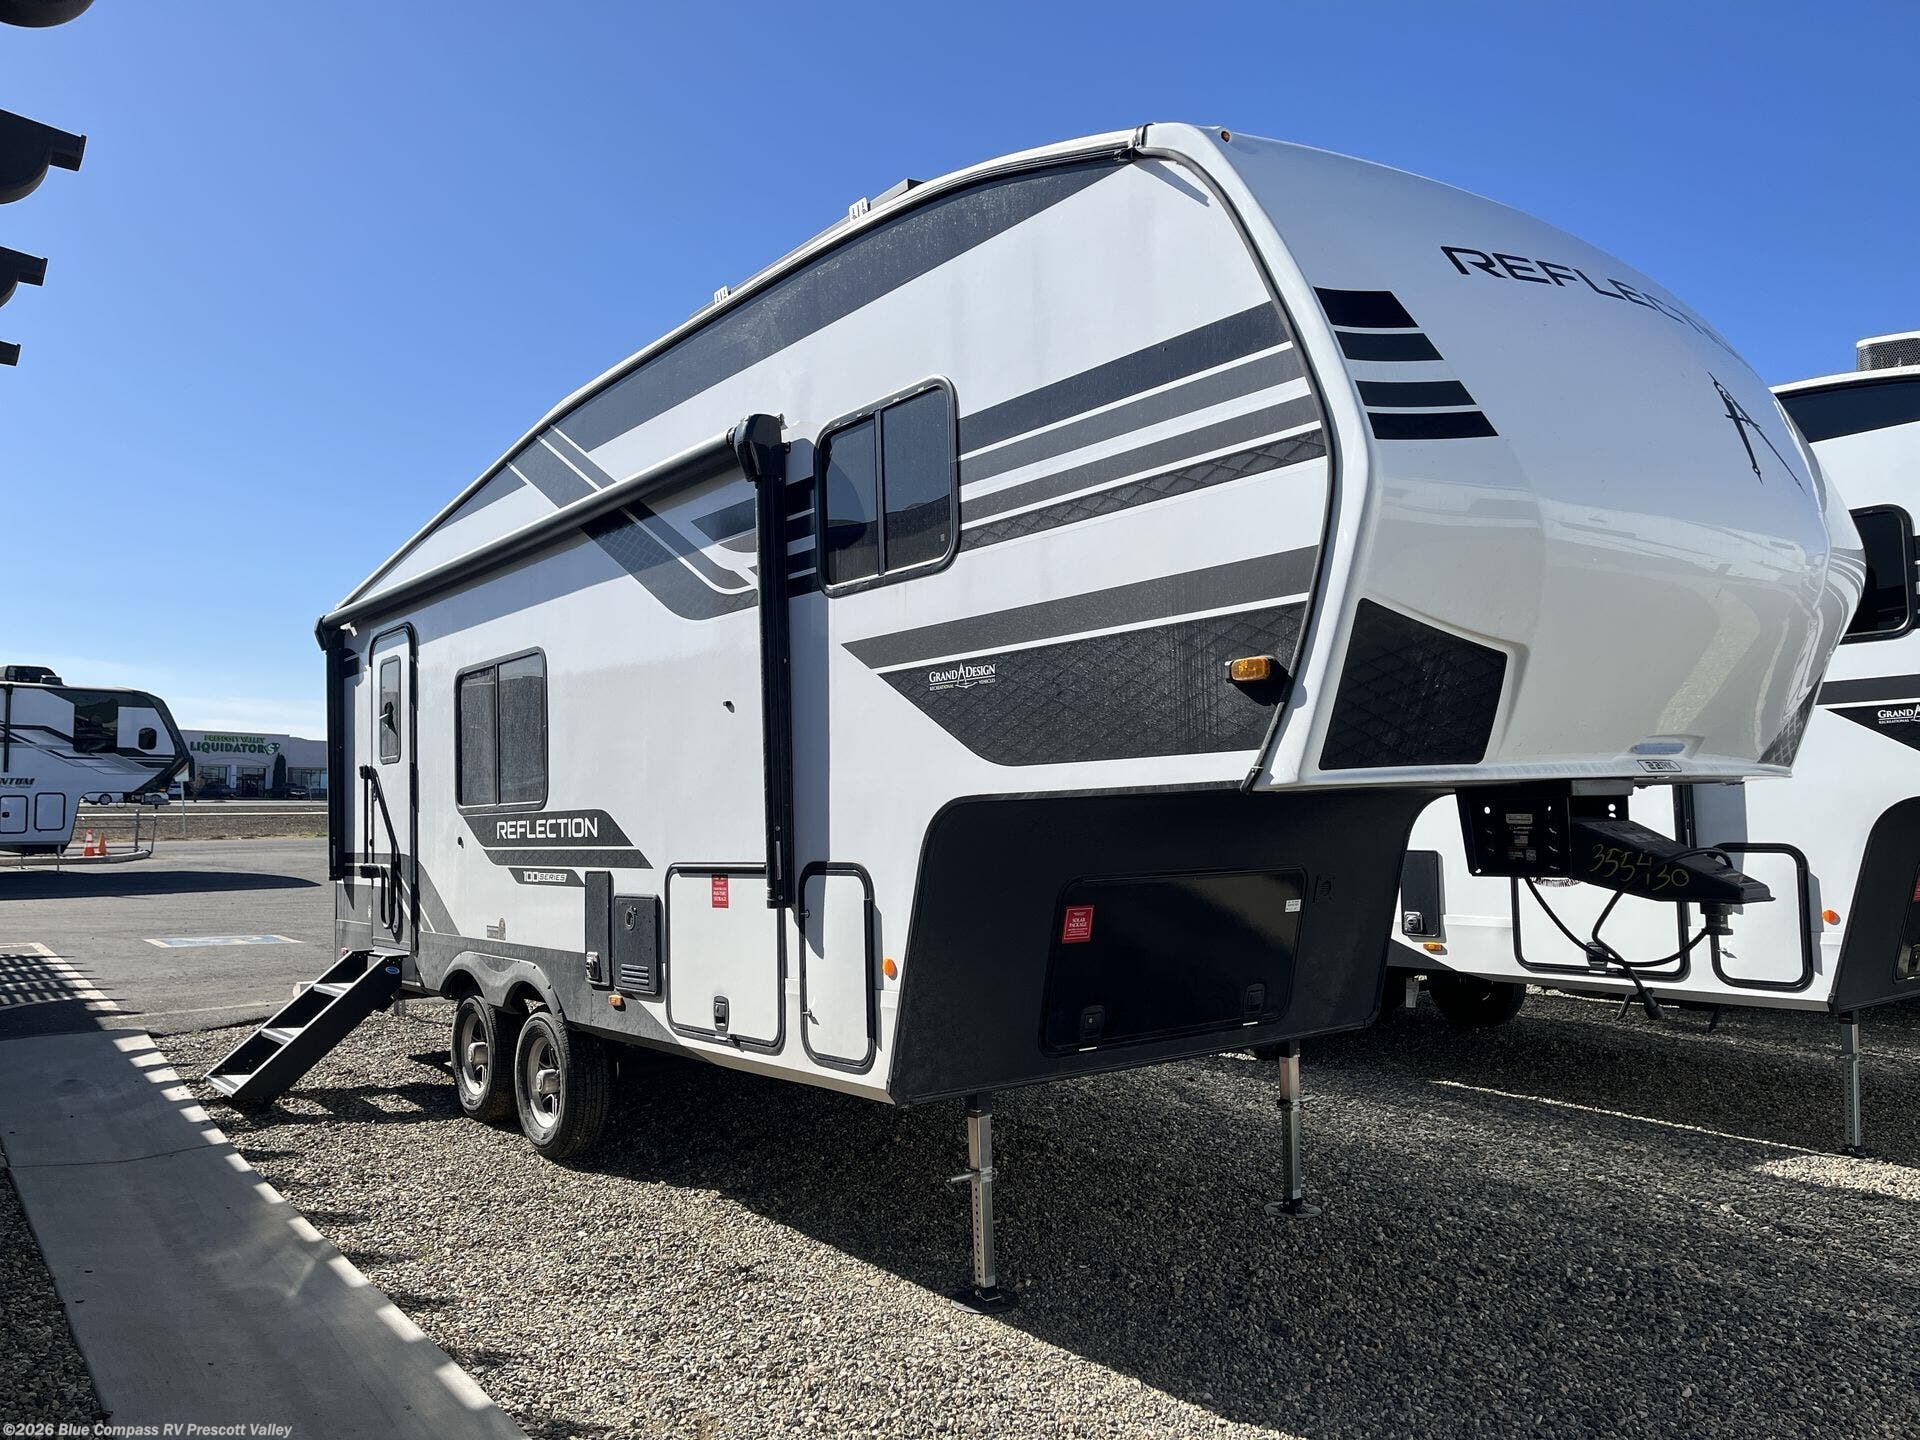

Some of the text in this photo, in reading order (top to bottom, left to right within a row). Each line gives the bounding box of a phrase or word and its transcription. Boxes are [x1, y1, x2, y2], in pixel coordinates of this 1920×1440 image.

[928, 663, 997, 683] GRAND DESIGN
[1877, 708, 1914, 719] GRAND
[496, 817, 599, 840] REFLECTION
[523, 871, 567, 882] 100 SERIES
